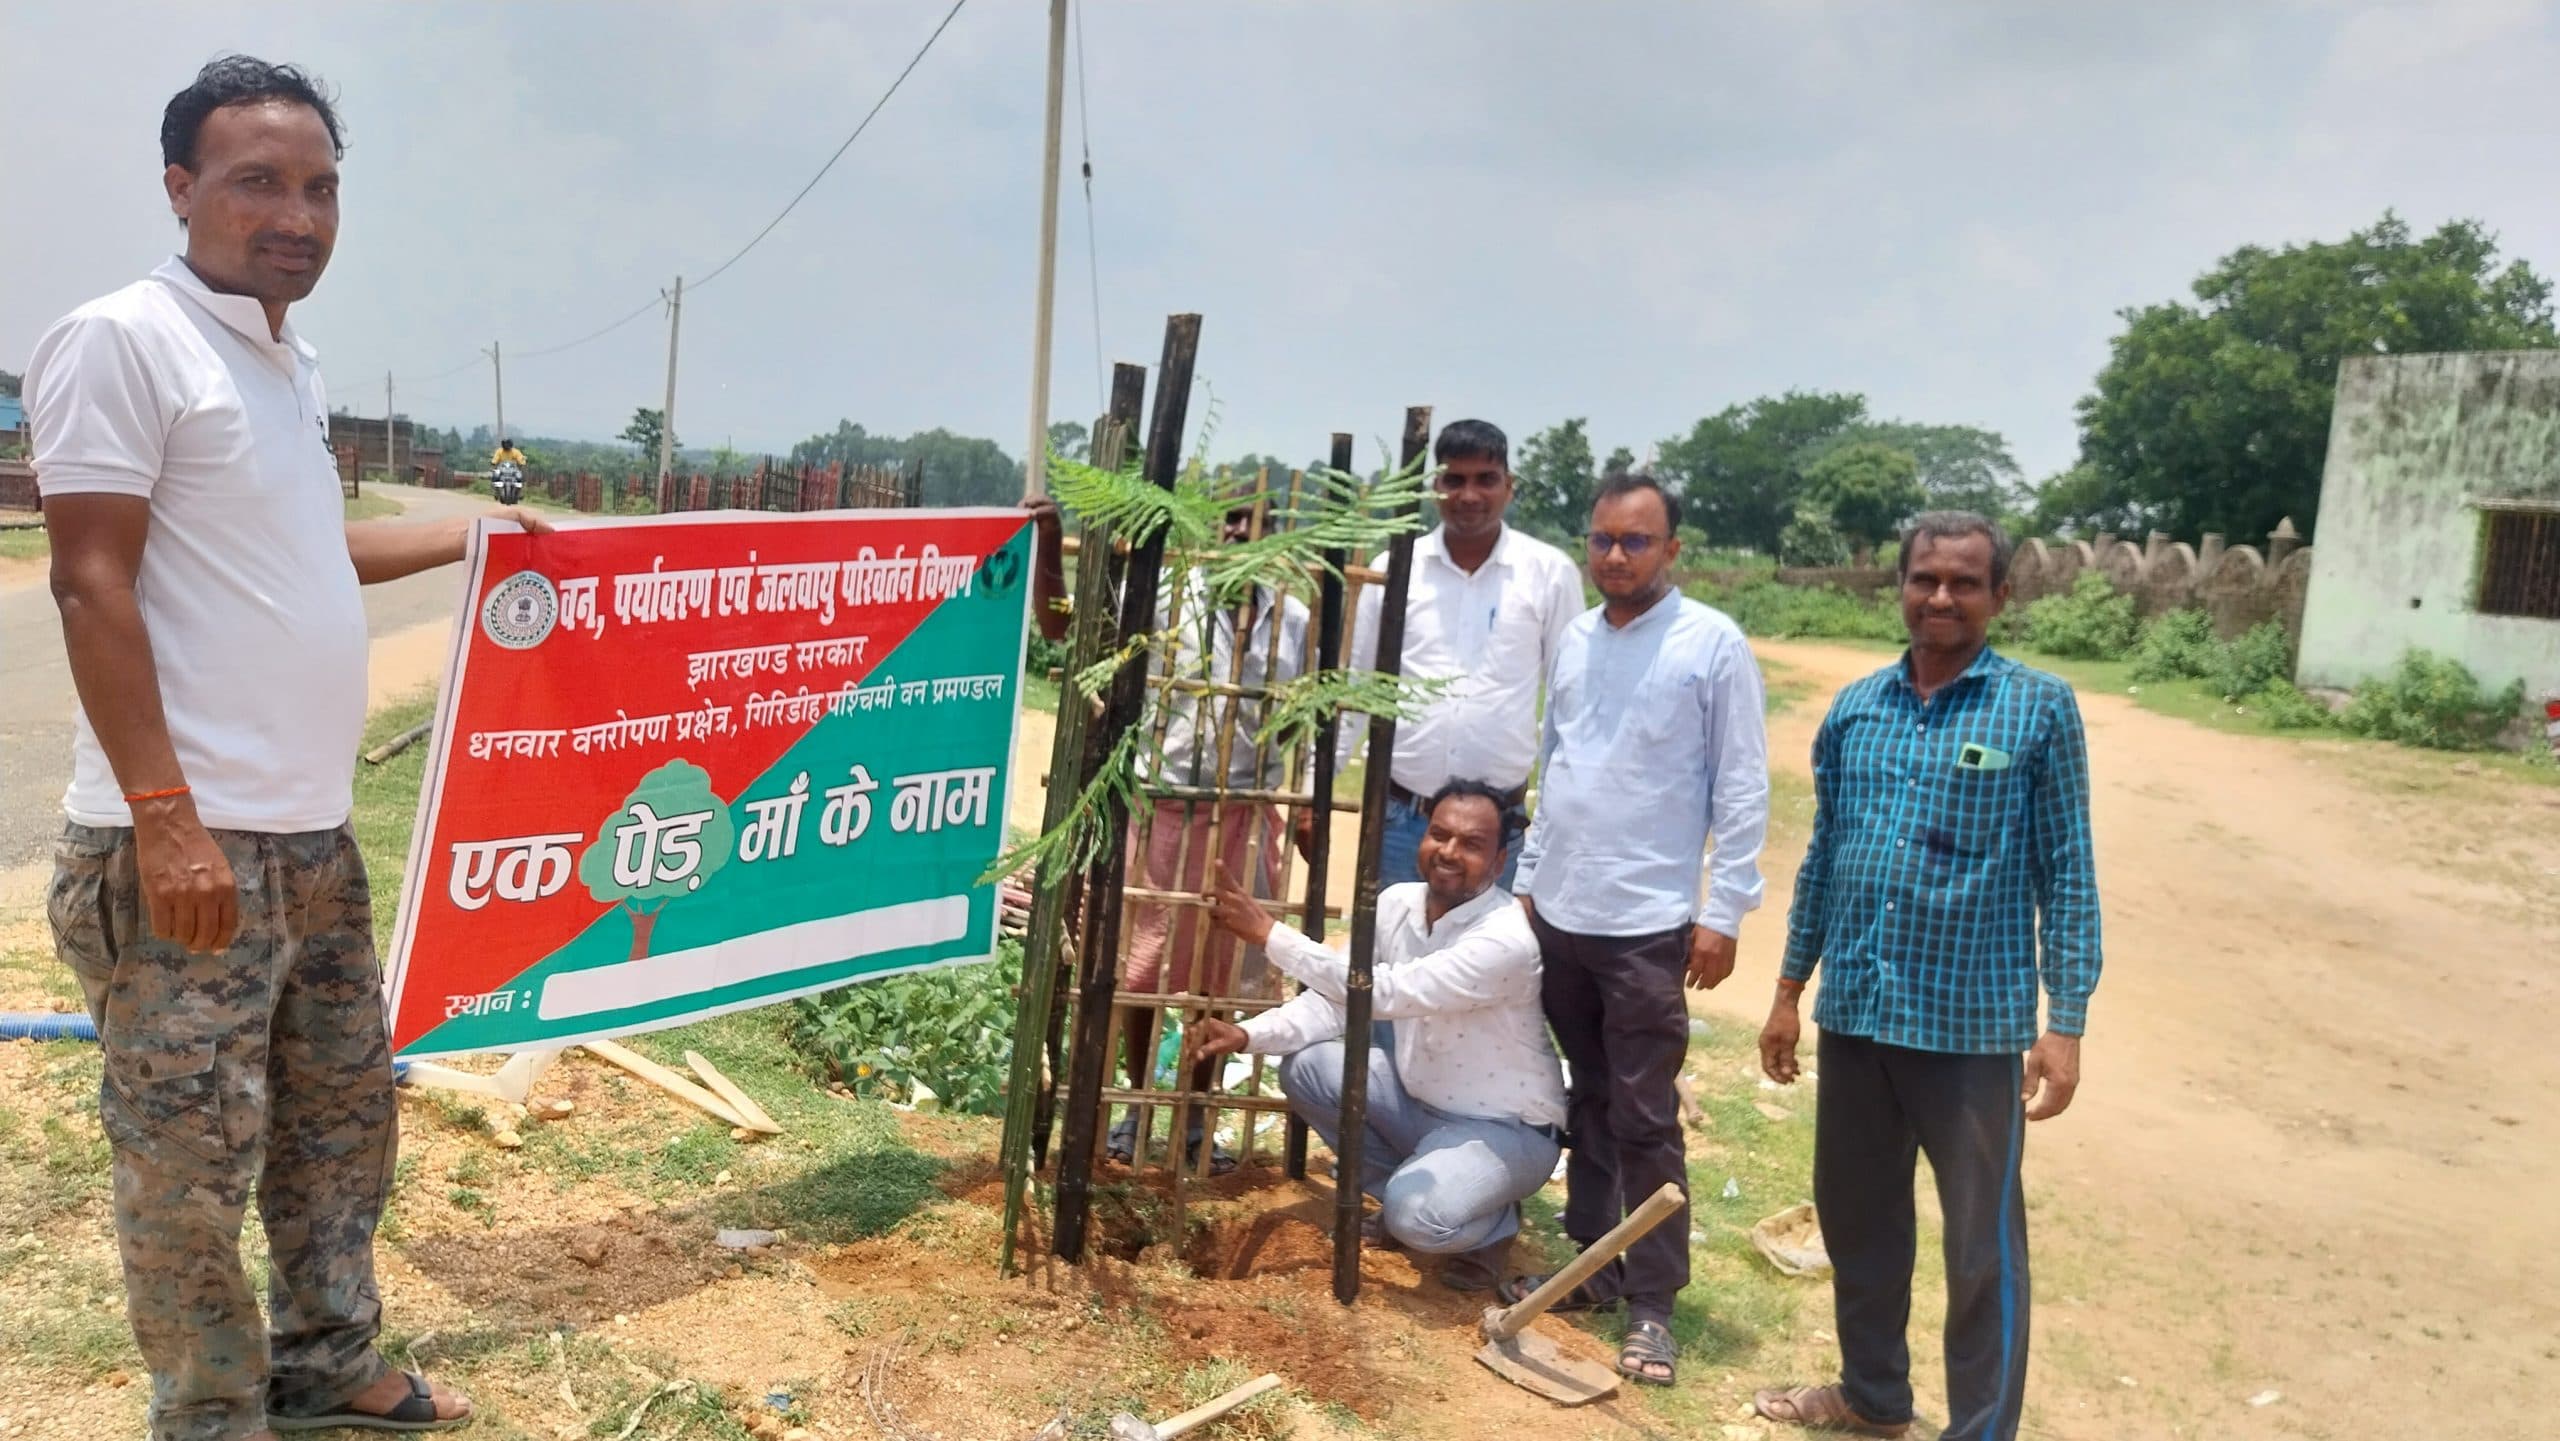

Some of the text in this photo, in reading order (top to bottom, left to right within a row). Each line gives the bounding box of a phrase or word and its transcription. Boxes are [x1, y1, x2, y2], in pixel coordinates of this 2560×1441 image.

[559, 576, 606, 640] वन,
[614, 556, 716, 625] पर्यावरण
[718, 550, 757, 617] एवं
[756, 561, 840, 626] जलवायु
[841, 544, 918, 607] परिवर्तन
[918, 543, 978, 601] विभाग
[687, 636, 869, 691] झारखण्ड सरकार
[469, 674, 1005, 760] धनवार वनरोपण प्रक्षेत्र, गिरिडीह पश्चिमी वन प्रमण्डल
[449, 764, 997, 911] एक पेड़ माँ के नाम
[444, 988, 517, 1019] स्थान
